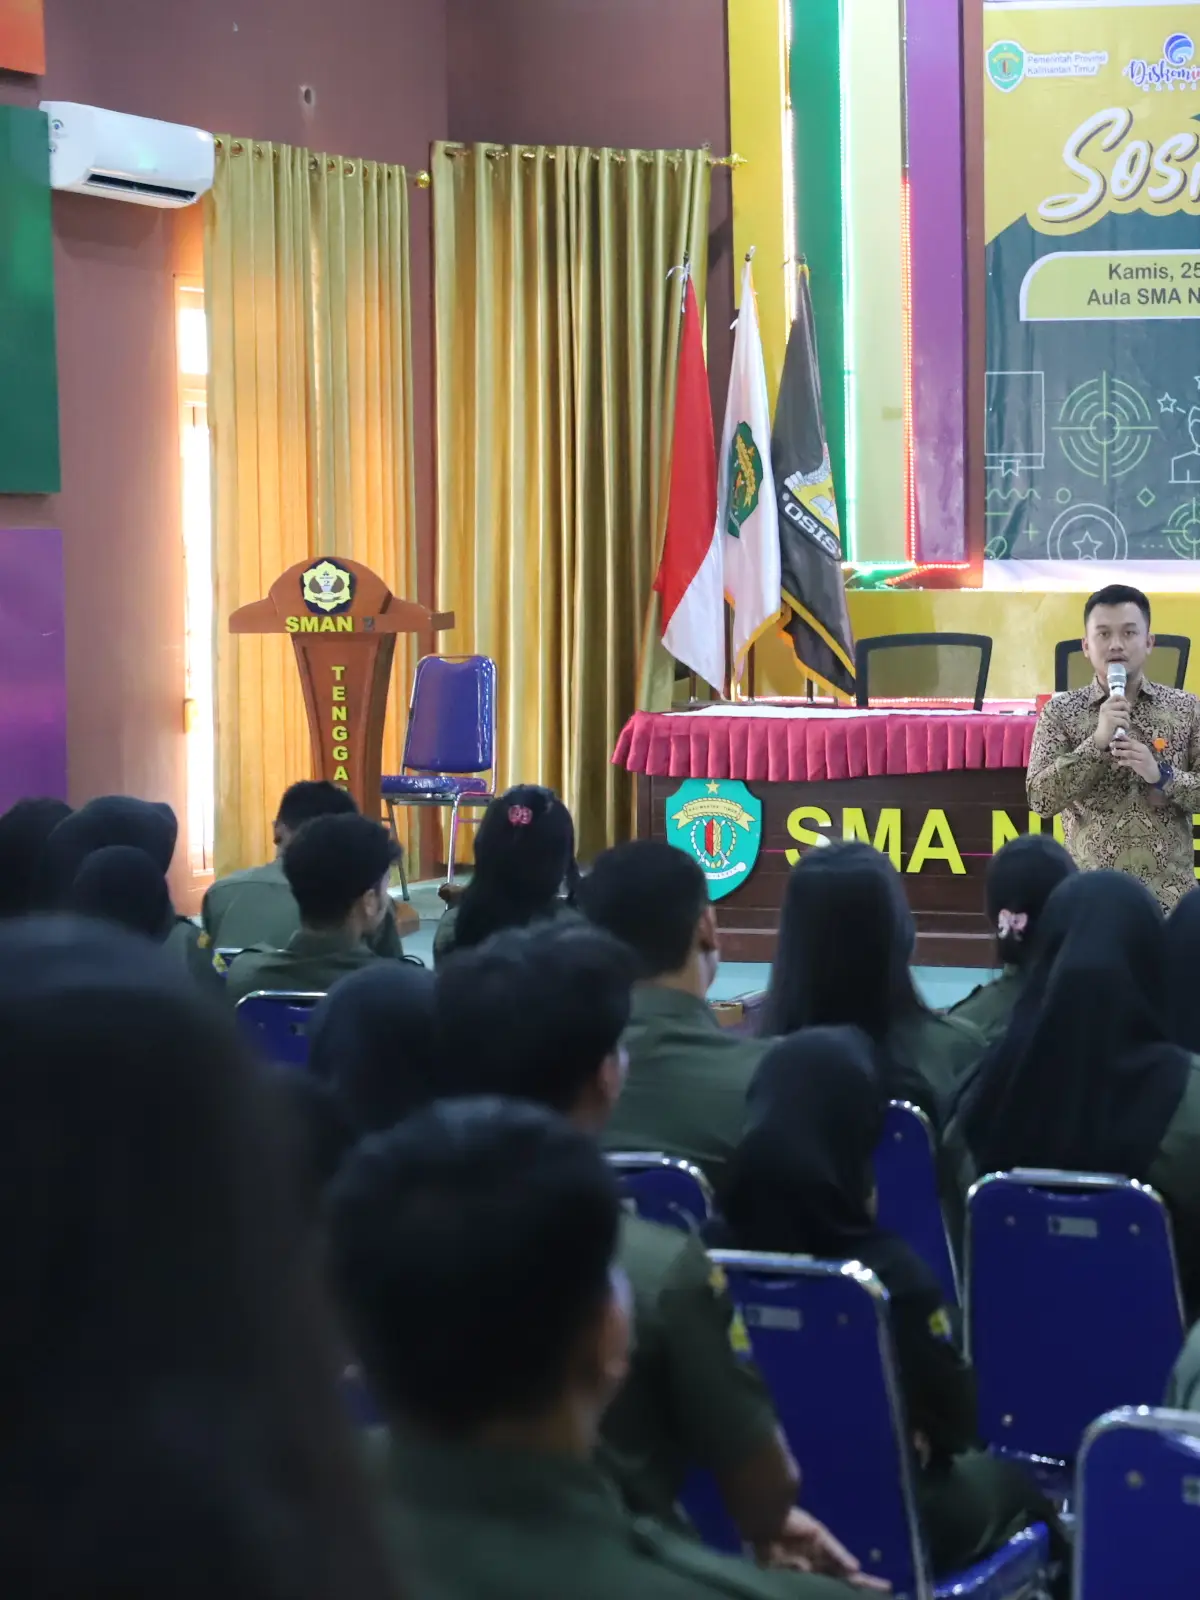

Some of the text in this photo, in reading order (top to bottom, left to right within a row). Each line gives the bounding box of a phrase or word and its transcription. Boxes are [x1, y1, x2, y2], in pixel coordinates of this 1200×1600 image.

[1027, 53, 1106, 64] Pemerintah Provinsi
[1074, 65, 1095, 74] Timur
[1108, 263, 1174, 281] Kamis,
[1087, 288, 1131, 306] Aula
[1137, 287, 1182, 305] SMA
[784, 502, 838, 554] OSIS
[285, 615, 353, 633] SMAN
[331, 665, 349, 793] TENGGA
[785, 806, 967, 875] SMA
